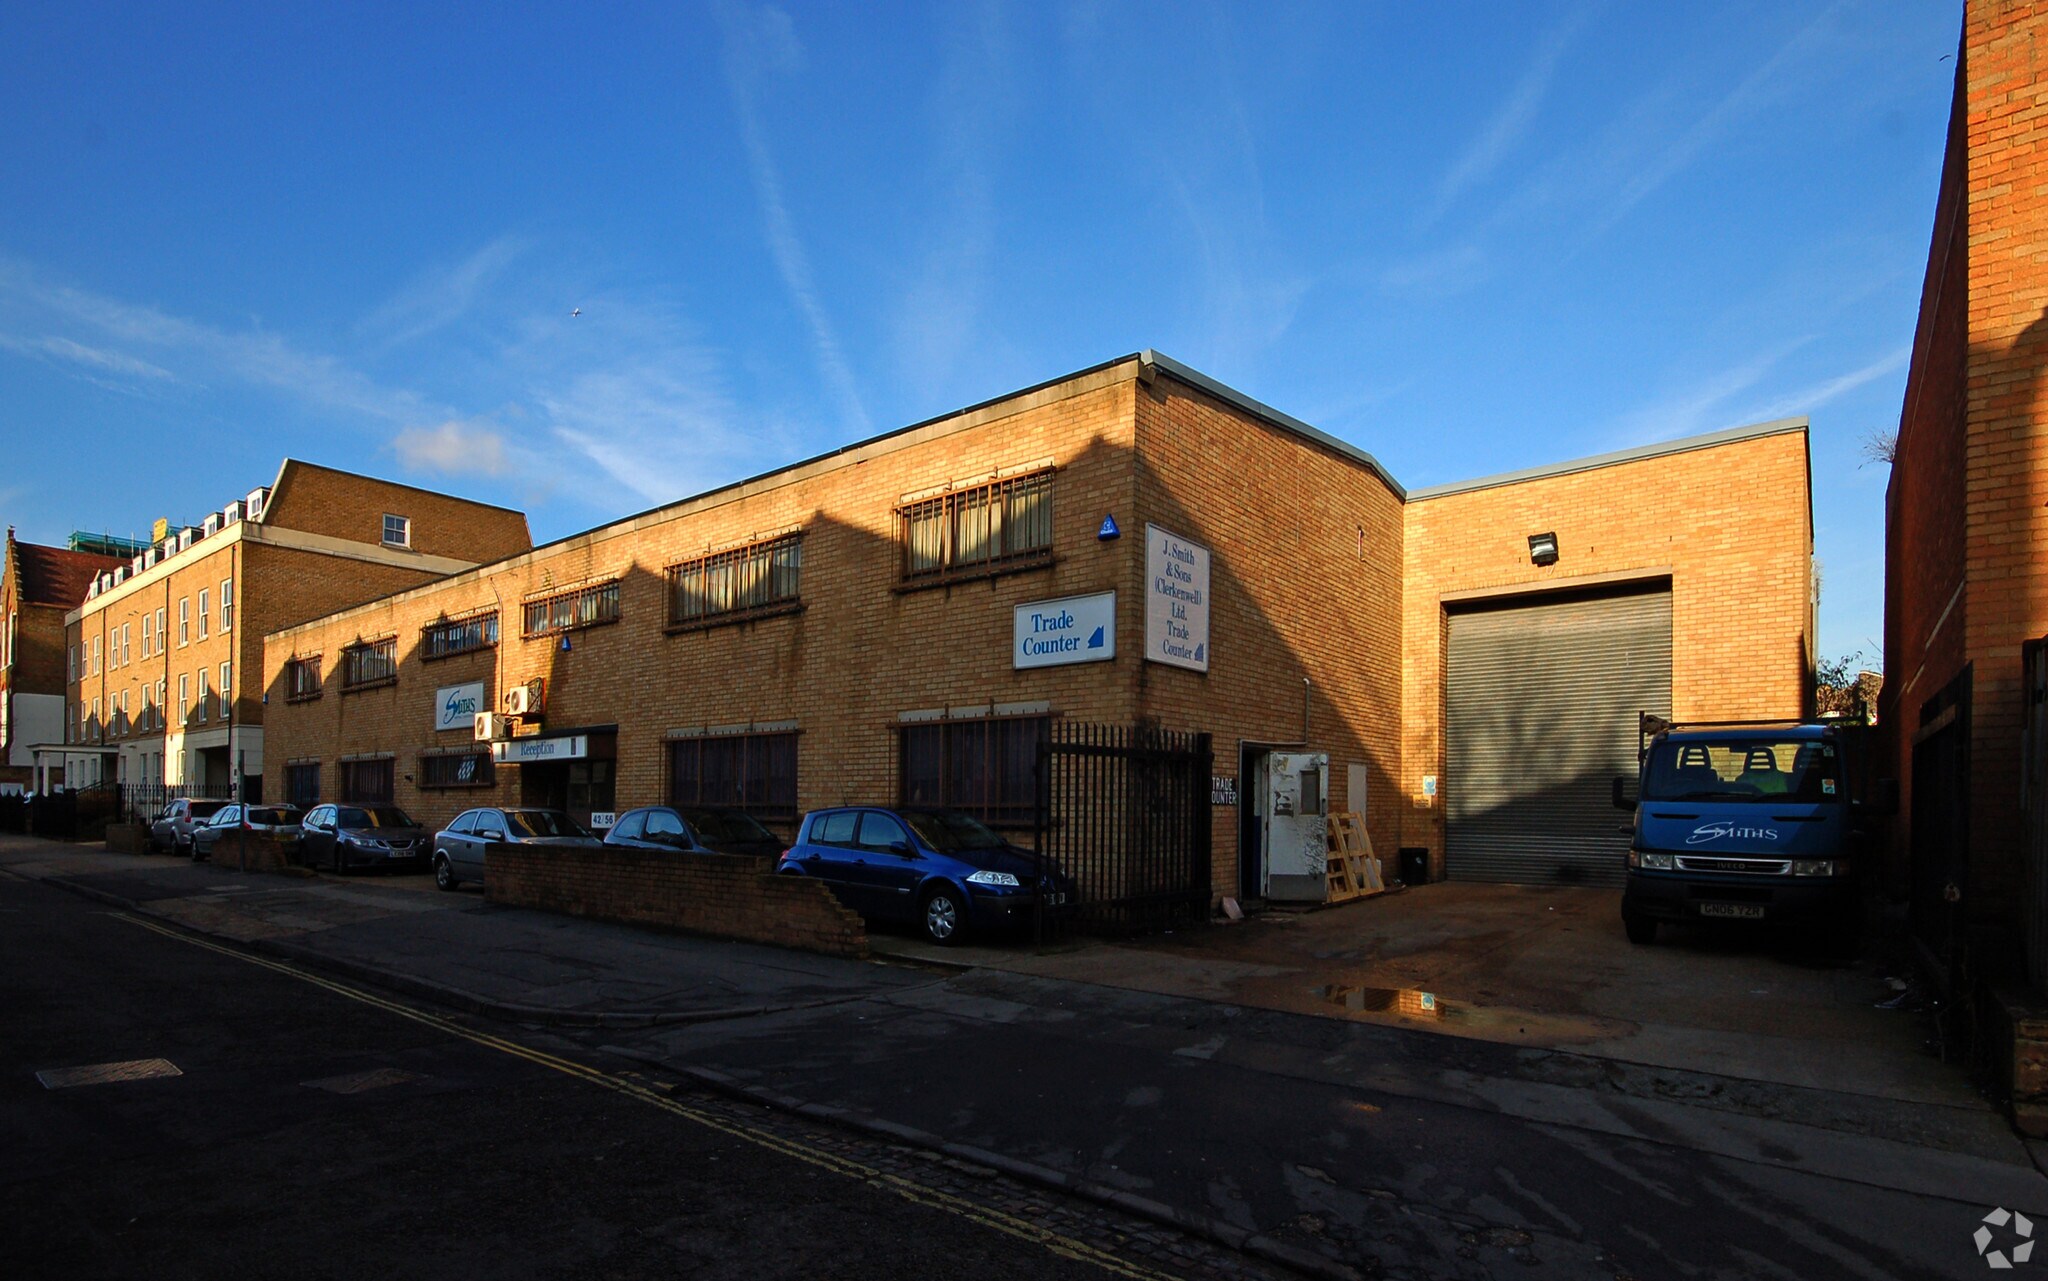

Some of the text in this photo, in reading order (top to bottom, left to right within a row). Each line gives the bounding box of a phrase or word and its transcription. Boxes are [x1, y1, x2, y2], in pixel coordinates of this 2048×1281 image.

[1172, 543, 1195, 565] Smith
[1165, 561, 1192, 583] & Sons
[1155, 576, 1202, 605] (Clerkenwell)
[1031, 610, 1074, 633] Trade
[1171, 602, 1188, 621] Ltd.
[1167, 620, 1189, 640] Trade
[1023, 635, 1080, 656] Counter
[1162, 640, 1193, 660] Counter
[520, 741, 555, 758] Reception
[1211, 777, 1233, 791] TRADE
[1211, 791, 1237, 804] OUNTER
[1716, 862, 1747, 870] IVECO
[1704, 904, 1760, 917] GN06 YZR
